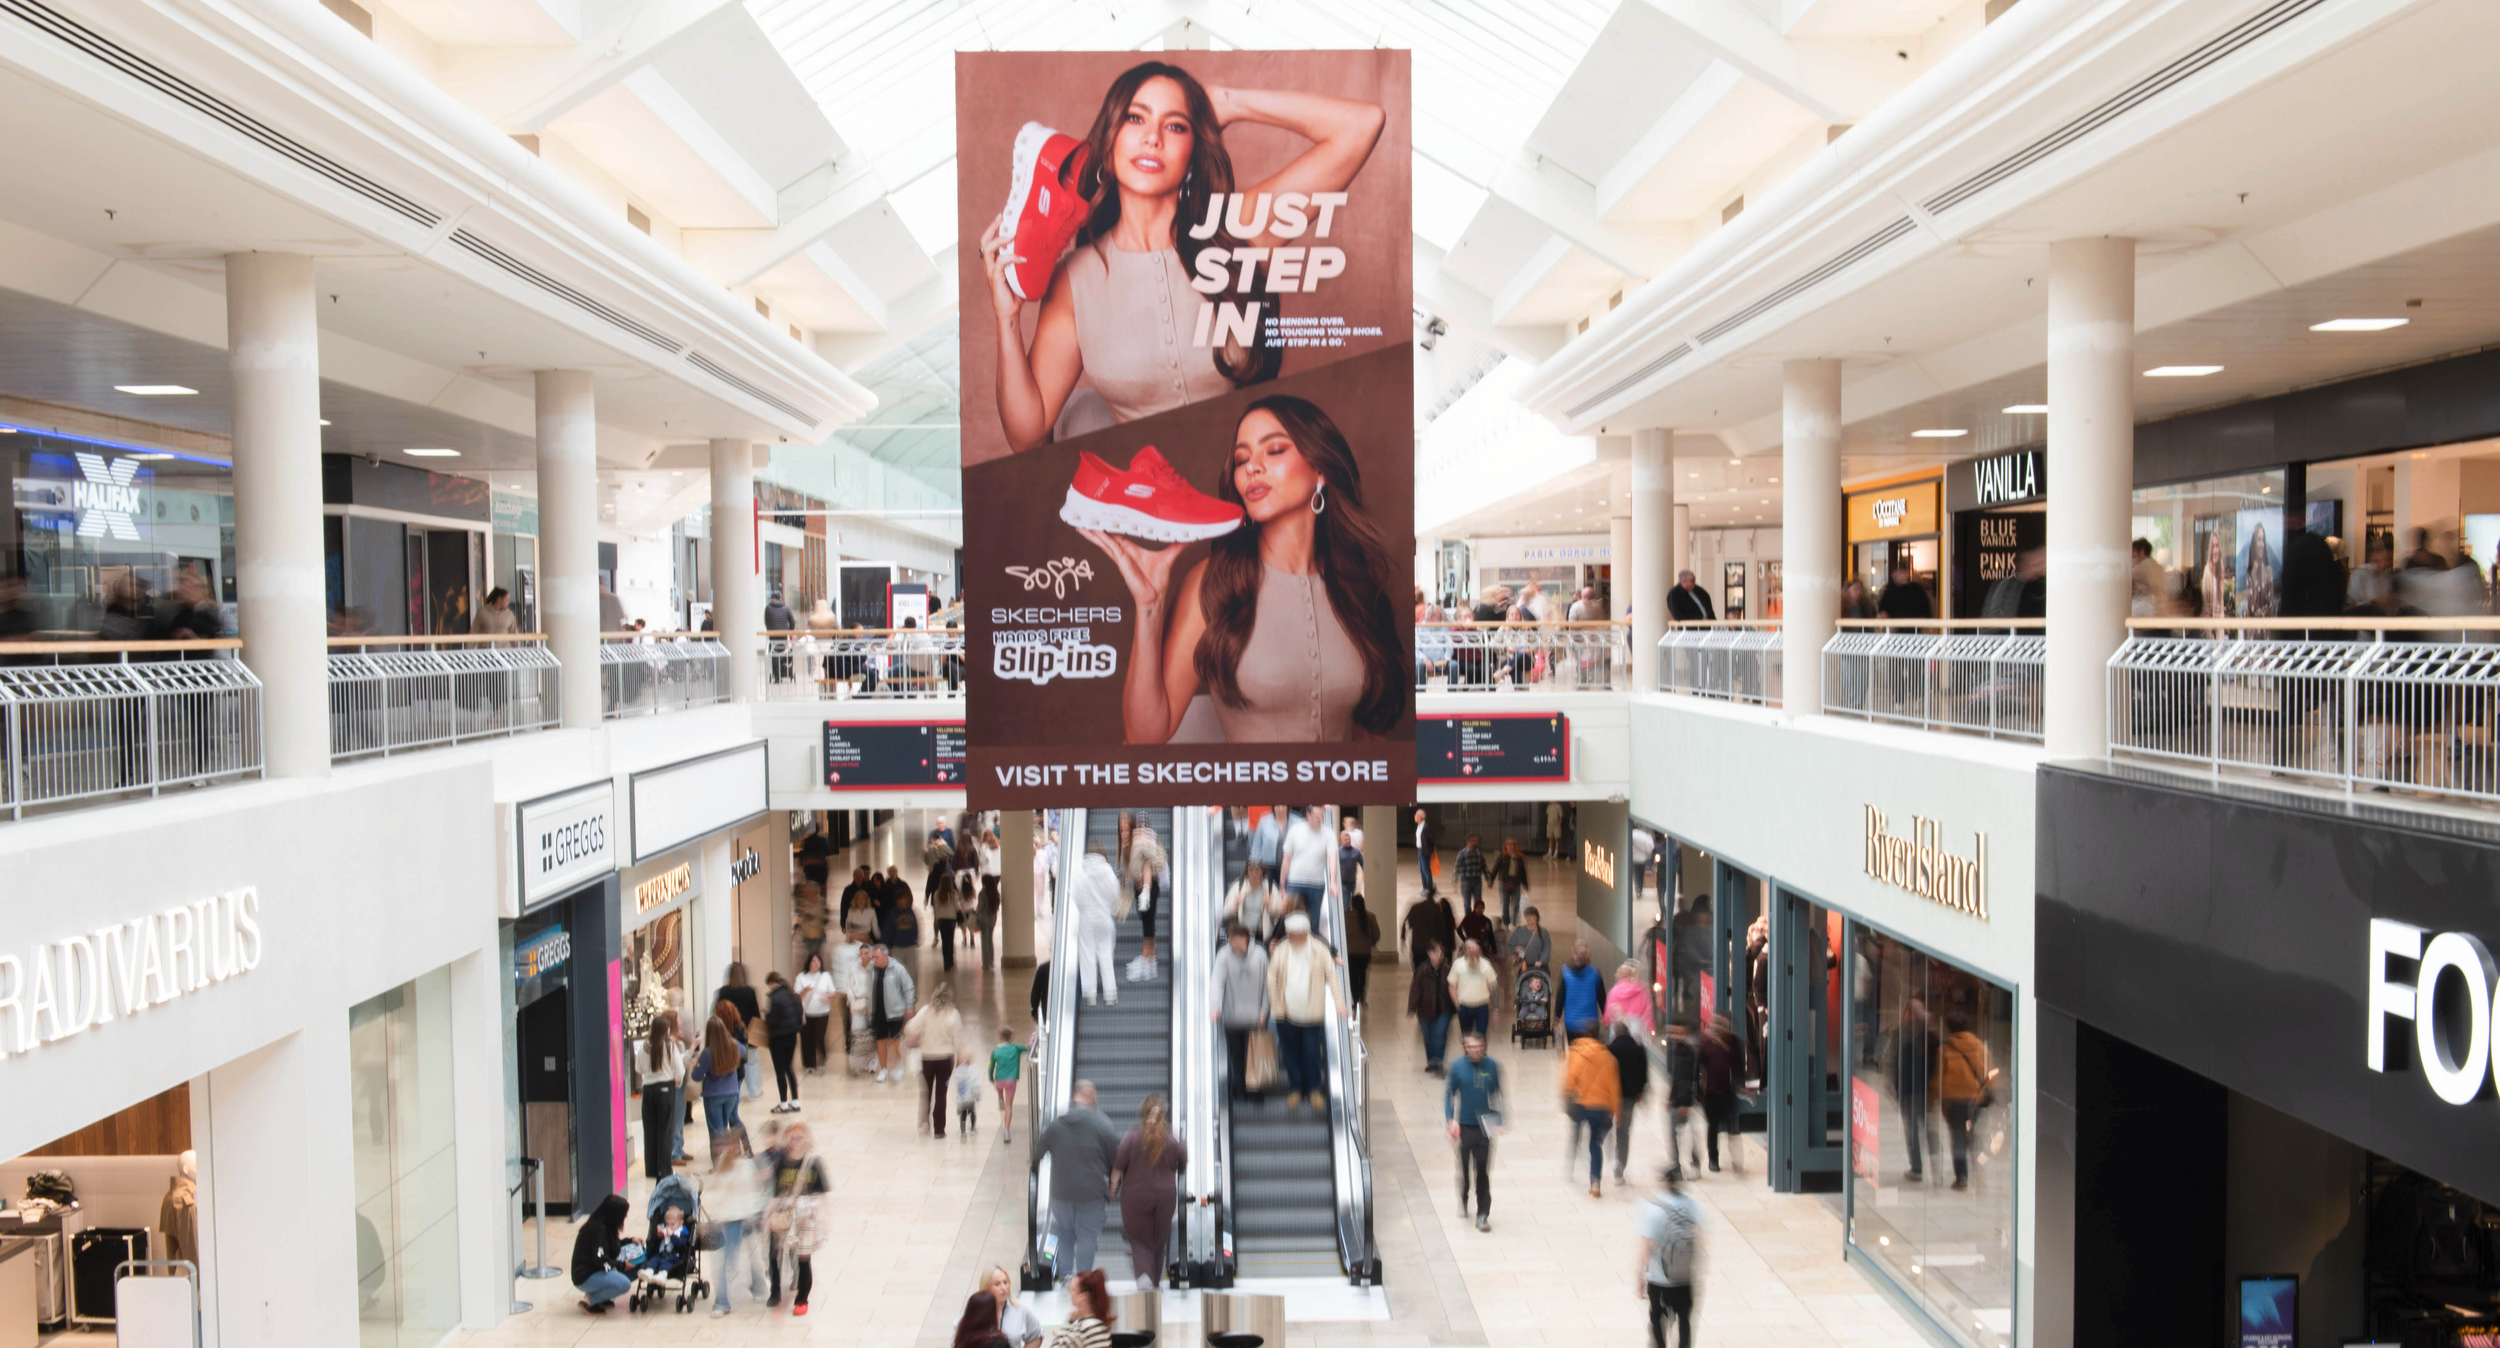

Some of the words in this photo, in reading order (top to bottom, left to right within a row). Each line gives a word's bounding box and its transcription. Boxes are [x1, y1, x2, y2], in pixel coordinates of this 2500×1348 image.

[1188, 192, 1348, 240] JUST
[1190, 246, 1346, 294] STEP
[1192, 301, 1261, 347] IN
[1265, 317, 1278, 327] NO
[1280, 317, 1318, 326] BENDING
[1320, 317, 1345, 326] OVER.
[1265, 327, 1278, 337] NO
[1280, 327, 1325, 337] TOUCHING
[1327, 327, 1351, 336] YOUR
[1353, 326, 1383, 336] SHOES.
[1265, 338, 1286, 347] JUST
[1287, 338, 1308, 347] STEP
[1310, 338, 1319, 347] IN
[1321, 338, 1326, 346] &
[1975, 450, 2036, 505] VANILLA
[73, 480, 141, 515] HALIFAX
[1980, 519, 2017, 537] BLUE
[1980, 536, 2017, 547] VANILLA
[1524, 549, 1554, 560] PARIS
[1980, 552, 2016, 569] PINK
[1980, 569, 2017, 580] VANILLA
[991, 607, 1122, 624] SKECHERS
[993, 629, 1048, 645] HANDS
[1050, 627, 1091, 644] FREE
[996, 643, 1115, 681] Slip-ins
[995, 764, 1068, 786] VISIT
[1074, 763, 1130, 785] THE
[1137, 760, 1289, 784] SKECHERS
[1296, 760, 1388, 782] STORE
[555, 814, 604, 866] GREGGS
[537, 931, 571, 972] GREGGS
[2368, 917, 2500, 1106] FO
